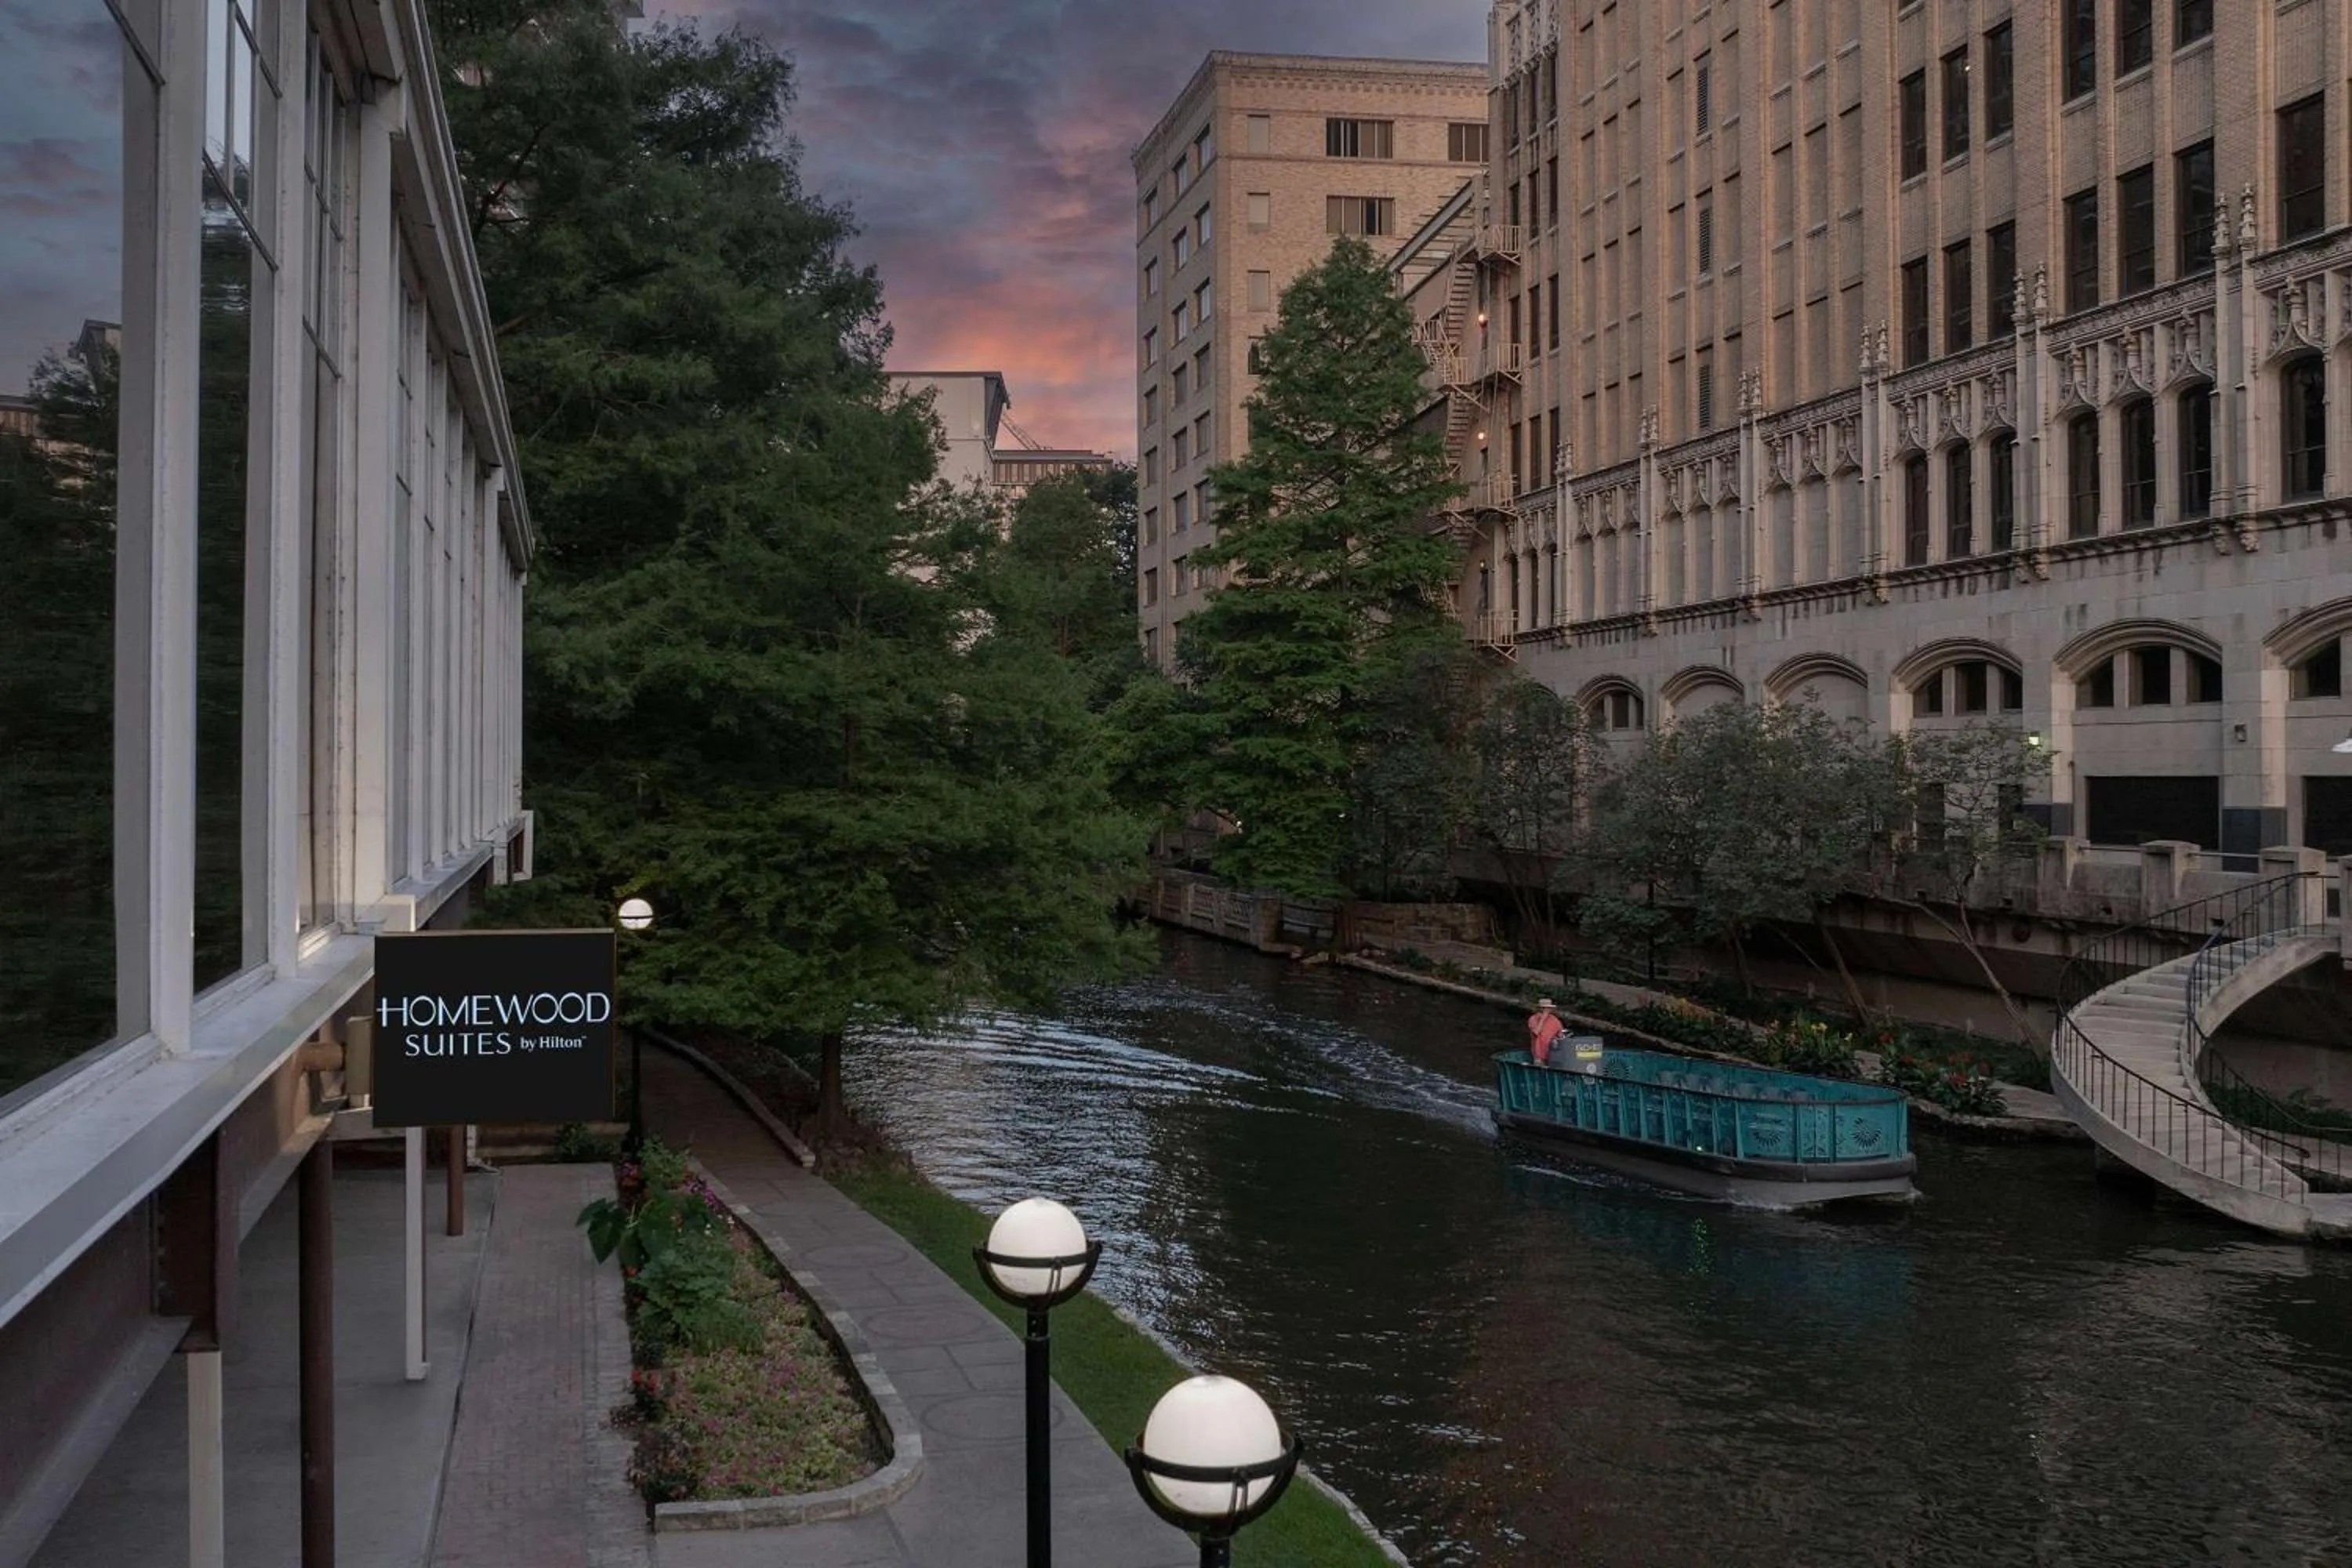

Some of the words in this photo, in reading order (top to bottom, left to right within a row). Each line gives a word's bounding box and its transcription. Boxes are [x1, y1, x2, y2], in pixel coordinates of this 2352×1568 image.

[376, 992, 611, 1027] HOMEWOOD
[405, 1032, 511, 1057] SUITES
[520, 1036, 537, 1053] by
[539, 1036, 583, 1049] Hilton
